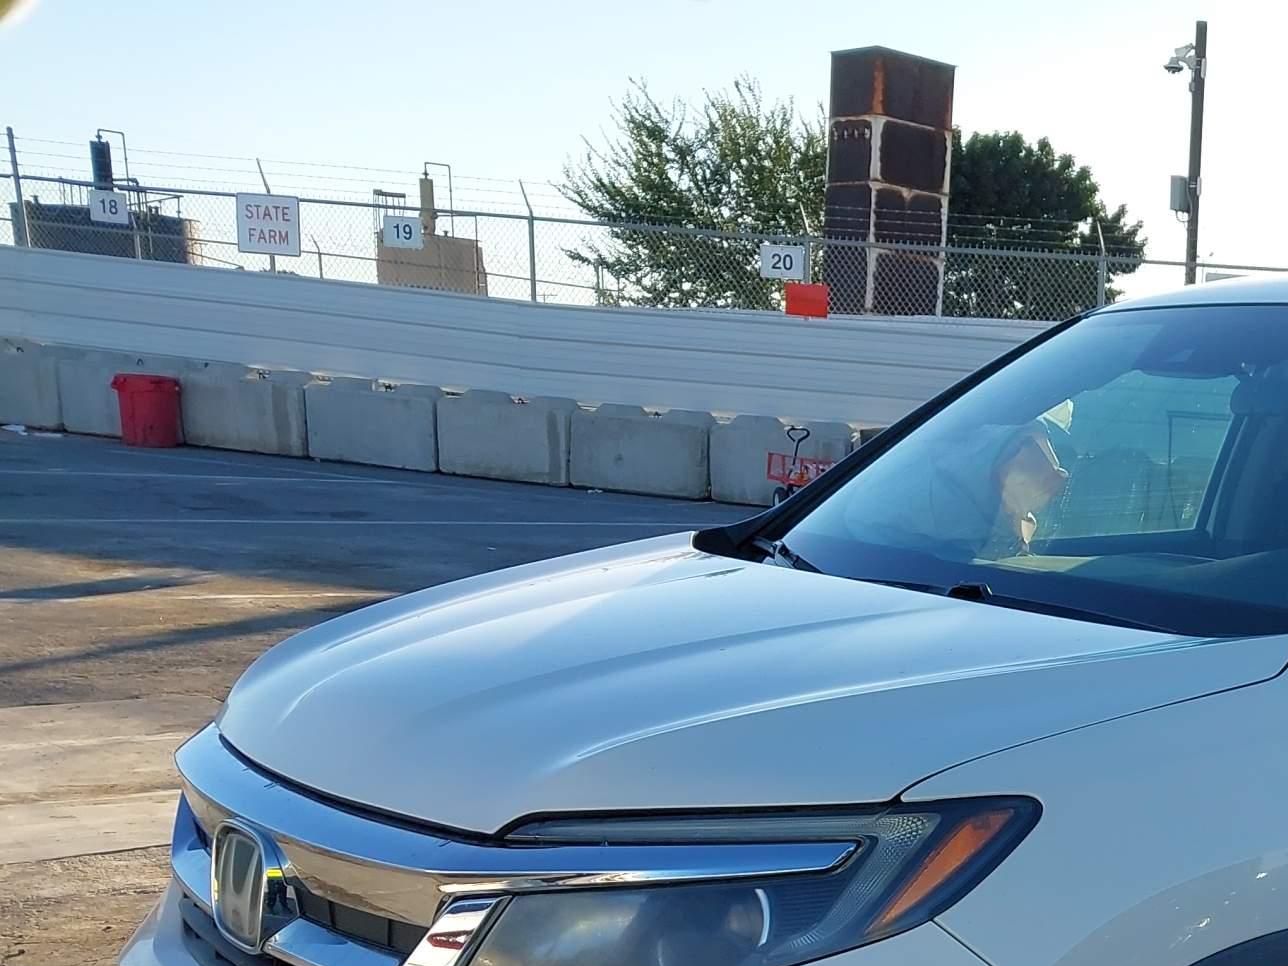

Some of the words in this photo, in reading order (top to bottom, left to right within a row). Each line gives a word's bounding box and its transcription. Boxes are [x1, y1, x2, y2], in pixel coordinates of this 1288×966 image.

[100, 198, 118, 215] 18
[245, 204, 291, 222] STATE
[248, 228, 289, 246] FARM
[393, 223, 413, 240] 19
[771, 253, 794, 271] 20
